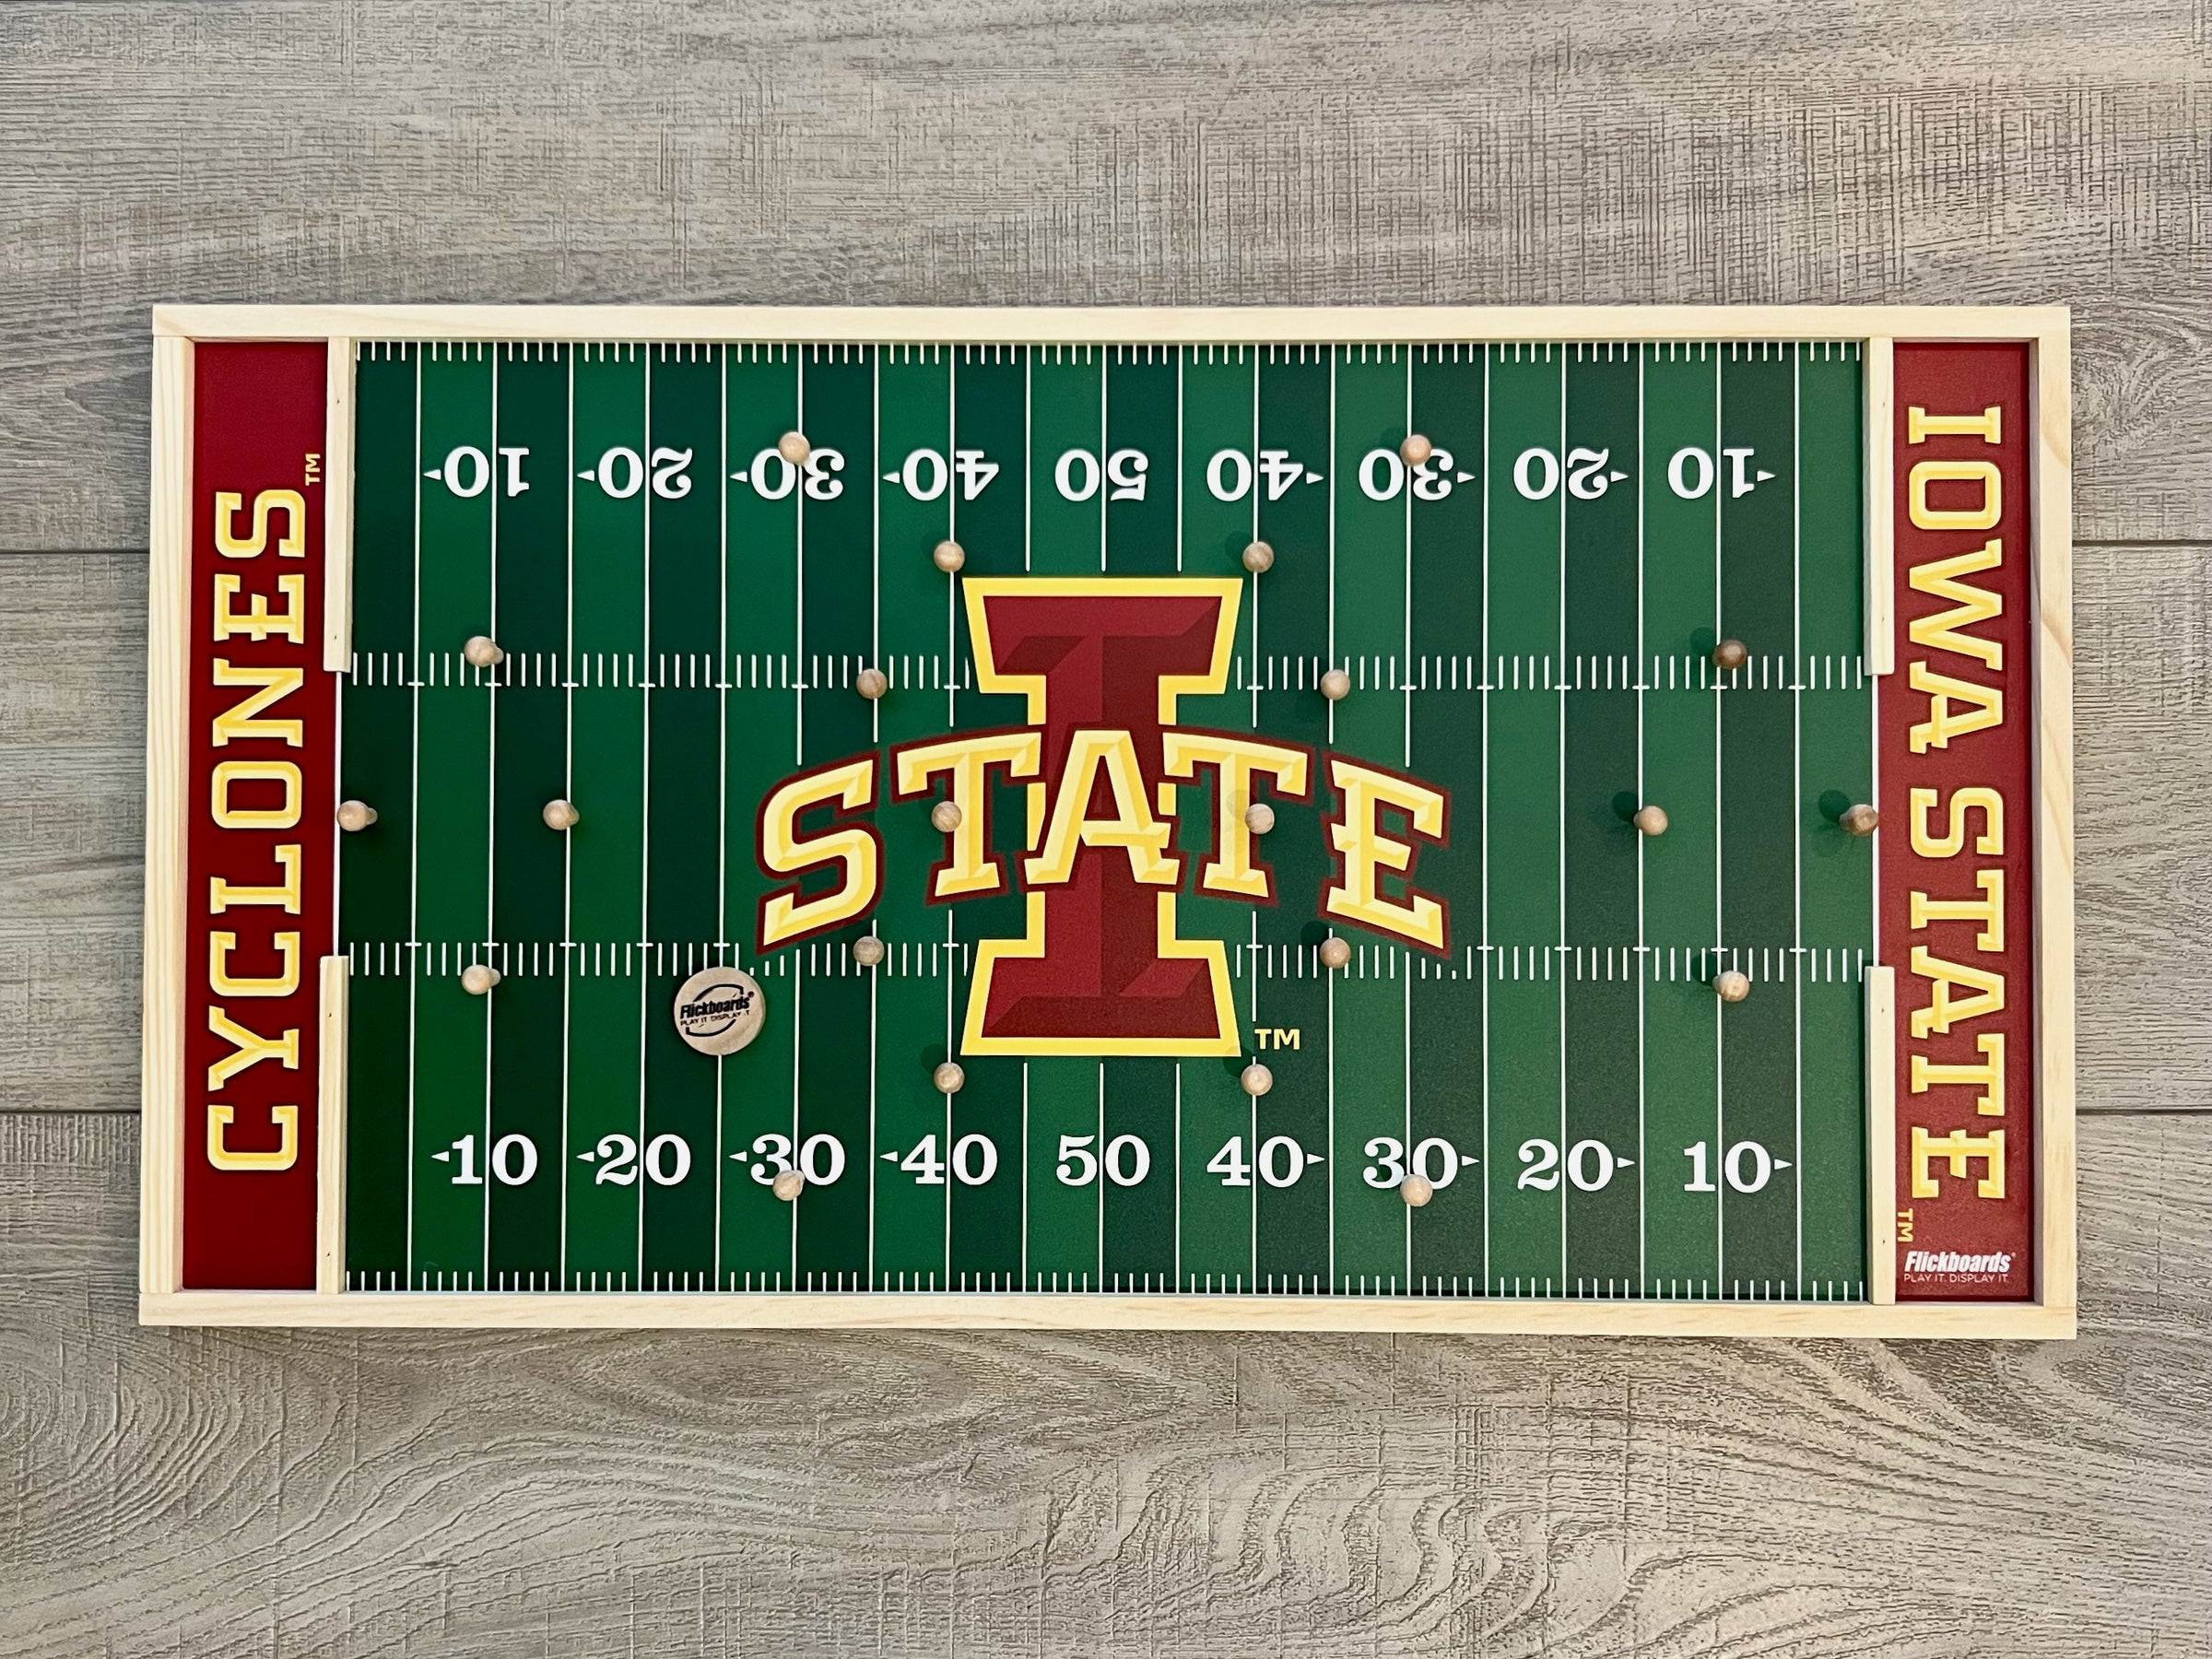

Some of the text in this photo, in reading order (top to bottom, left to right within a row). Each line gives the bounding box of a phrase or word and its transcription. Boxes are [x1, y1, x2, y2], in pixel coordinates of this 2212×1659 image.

[444, 446, 530, 498] 10
[597, 447, 693, 499] 20
[750, 448, 845, 500] 30
[902, 449, 999, 500] 40
[1054, 449, 1149, 501] 50
[1206, 448, 1304, 501] 40
[1359, 448, 1456, 501] 30
[1512, 447, 1609, 500] 20
[1667, 446, 1755, 500] 10
[1908, 406, 2006, 1199] IOWA STATE
[206, 488, 306, 1171] CYCLONES
[760, 728, 1448, 953] STATE
[450, 1134, 537, 1186] 10
[595, 1134, 690, 1186] 20
[750, 1134, 845, 1186] 30
[900, 1134, 997, 1186] 40
[1055, 1135, 1150, 1187] 50
[1206, 1135, 1304, 1188] 40
[1362, 1136, 1458, 1190] 30
[1517, 1138, 1614, 1192] 20
[1683, 1140, 1771, 1193] 10
[1903, 1273, 1932, 1283] PLAY
[1949, 1273, 1995, 1283] DISPLAY
[1904, 1250, 2011, 1273] Flickboards
